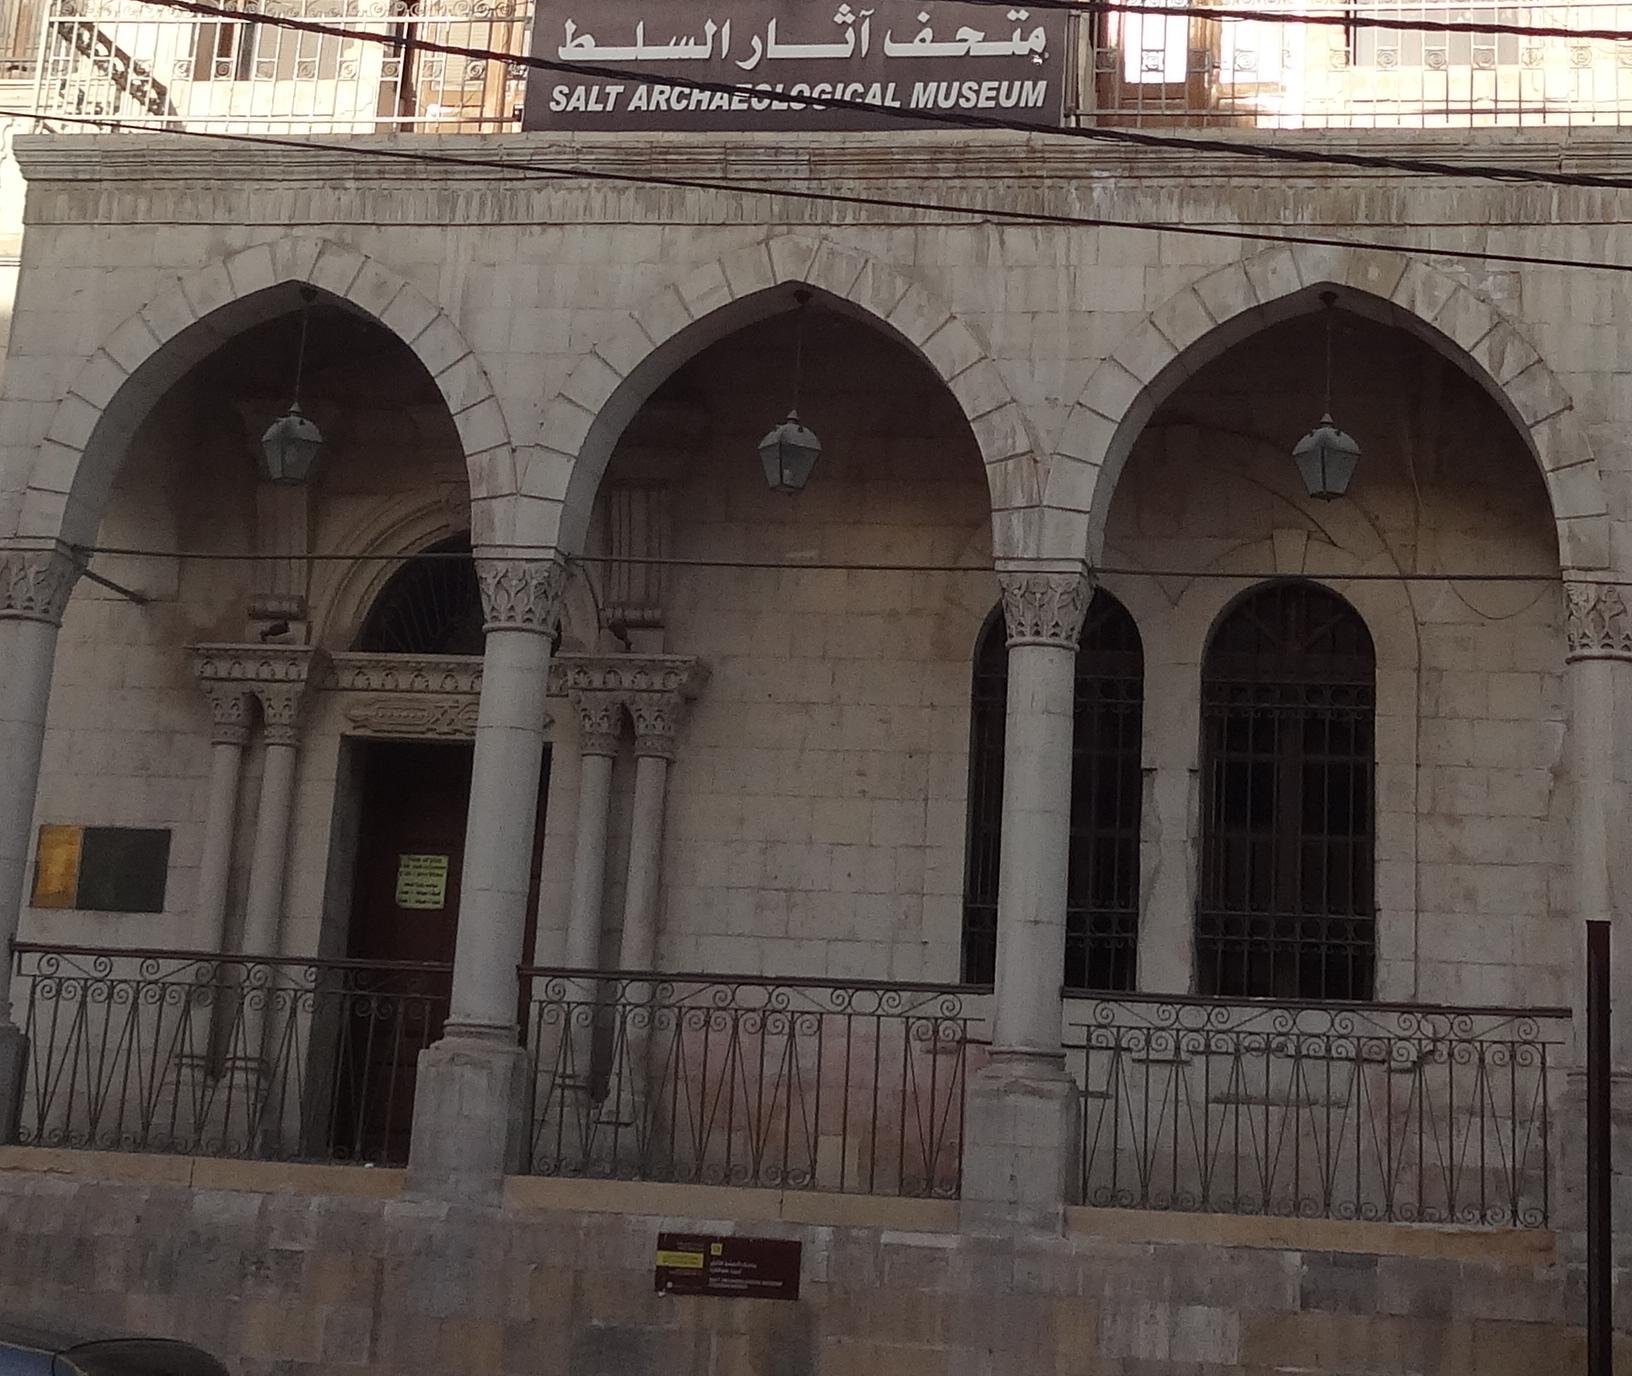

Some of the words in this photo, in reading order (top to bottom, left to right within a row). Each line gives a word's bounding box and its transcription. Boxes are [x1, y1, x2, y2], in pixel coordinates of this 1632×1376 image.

[557, 17, 730, 61] السلط
[736, 3, 871, 70] آثار
[884, 8, 1046, 59] متحف
[549, 84, 625, 112] SALT
[628, 82, 902, 111] ARCHAEOLOGICAL
[910, 81, 1048, 109] MUSEUM
